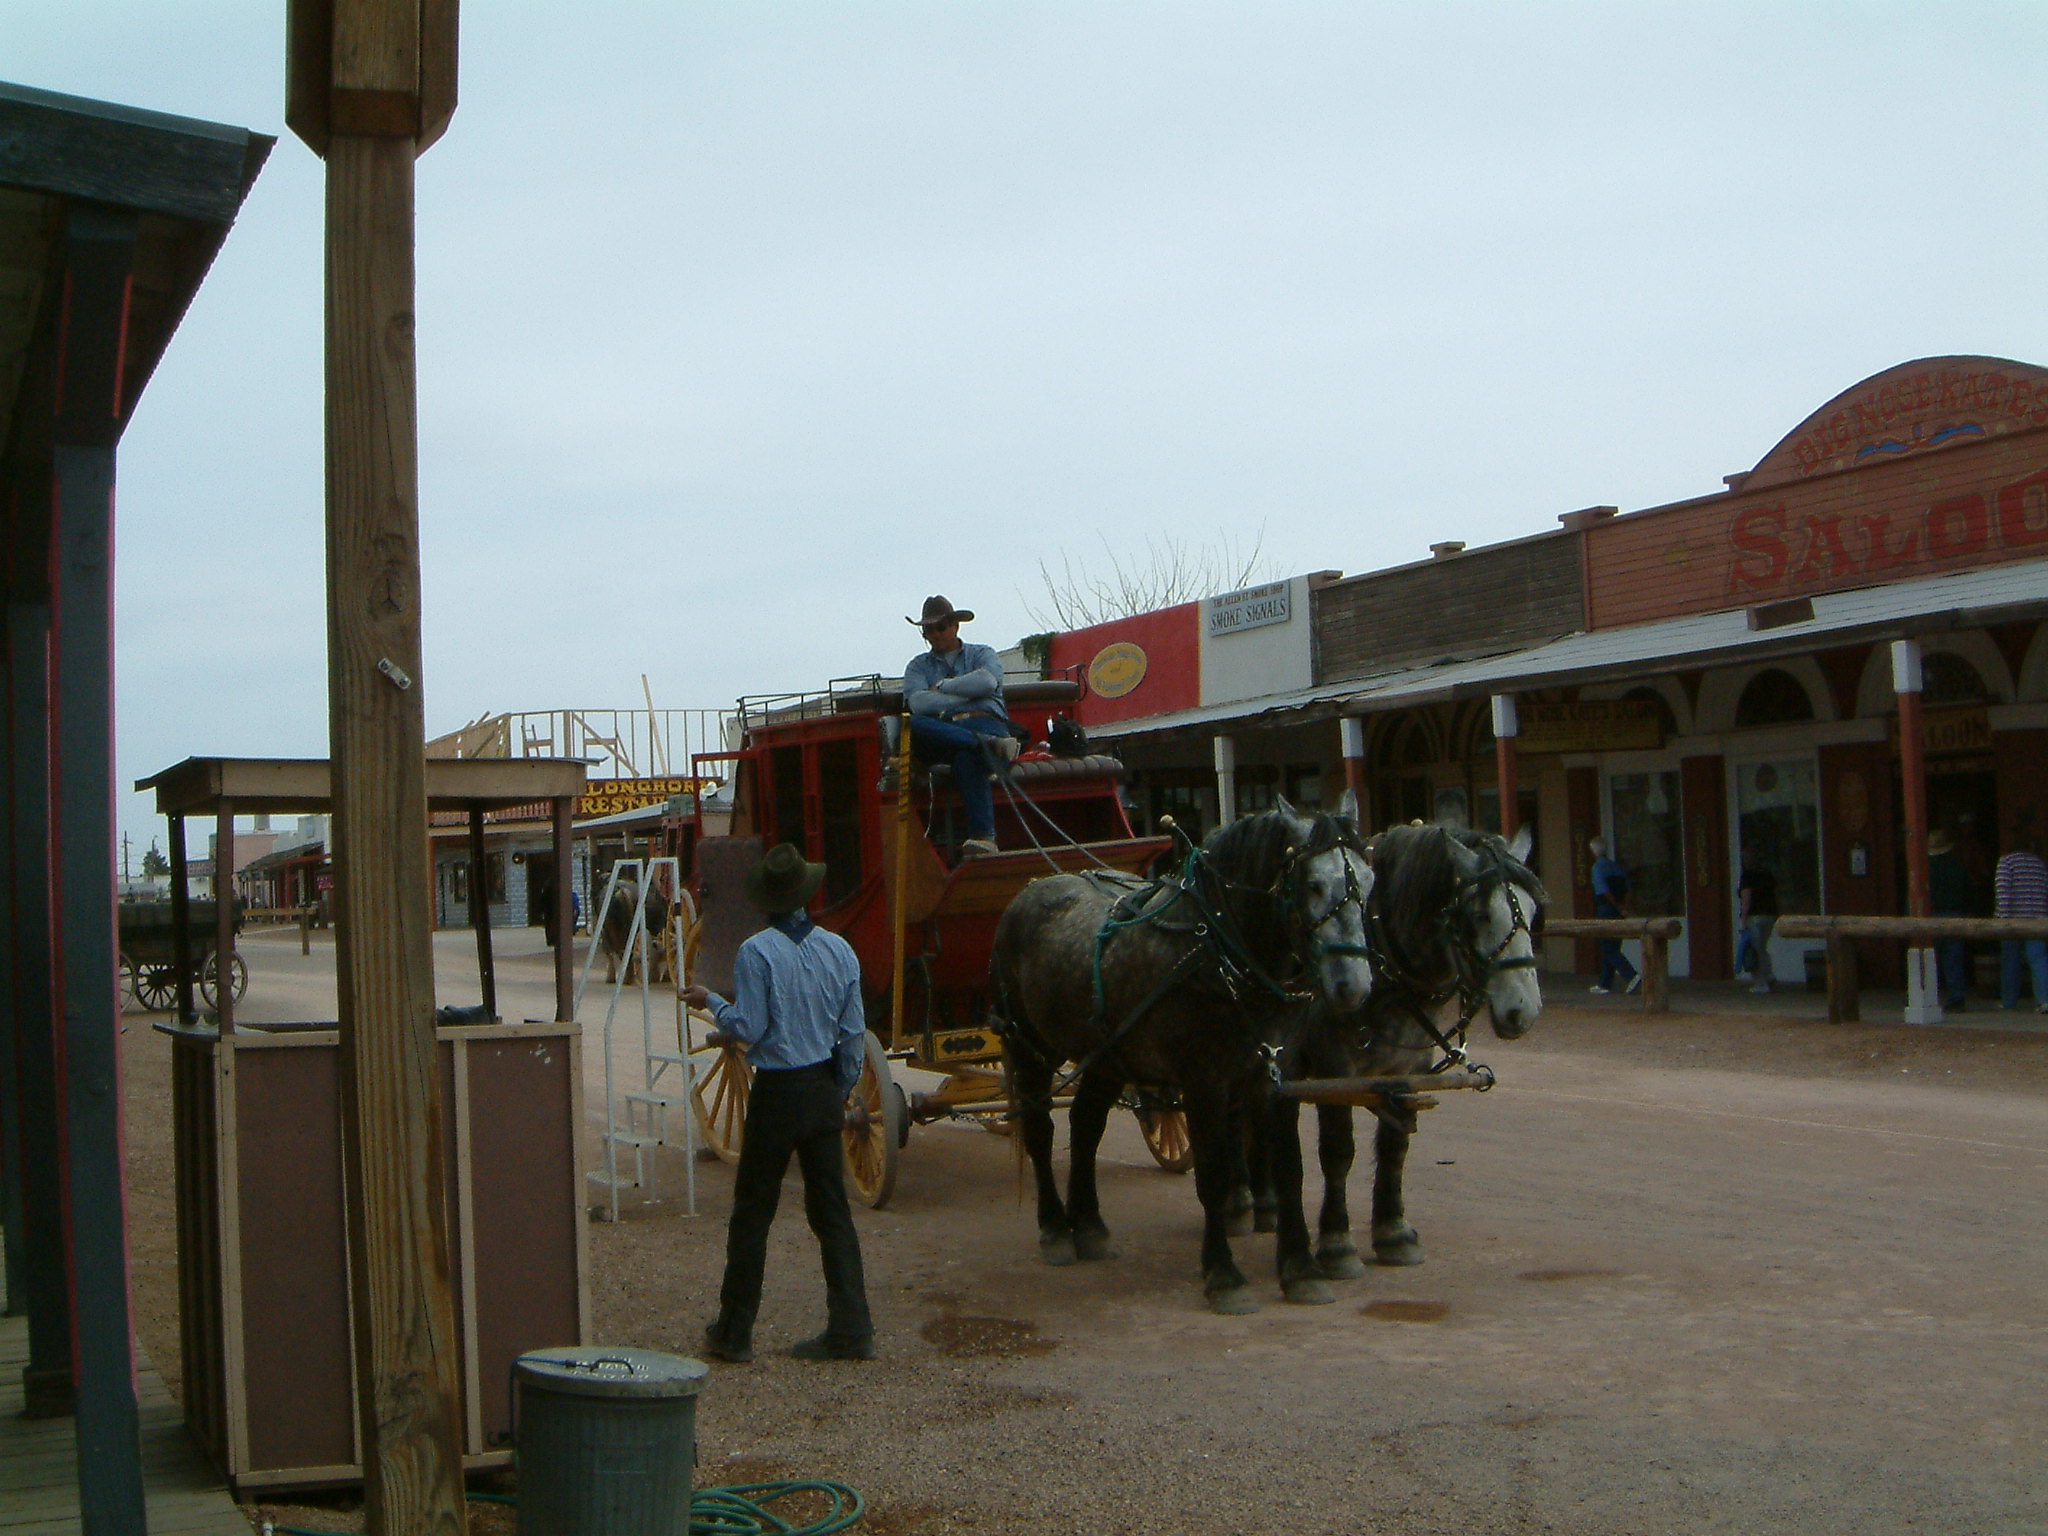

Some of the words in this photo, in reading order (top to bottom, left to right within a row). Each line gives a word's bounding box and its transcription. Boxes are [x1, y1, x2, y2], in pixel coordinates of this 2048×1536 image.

[1793, 410, 1851, 475] BIG
[1852, 374, 1931, 431] NOSE
[1211, 607, 1242, 631] SMOKE
[1246, 598, 1286, 623] SIGNALS
